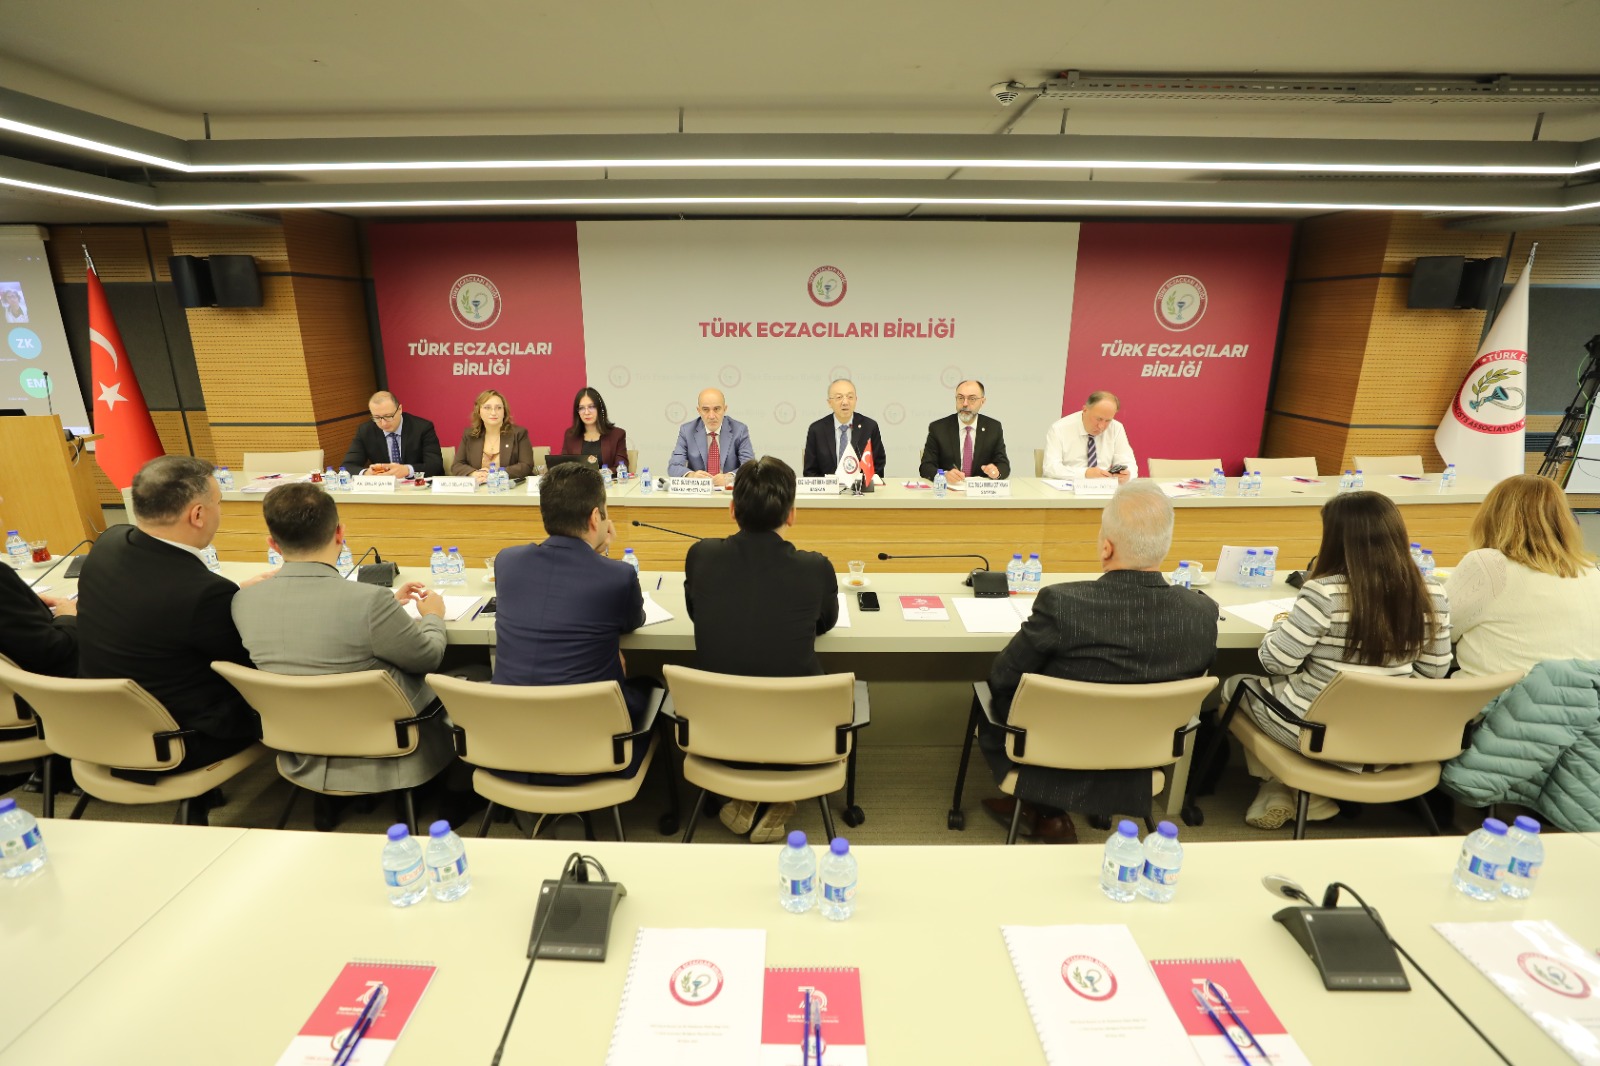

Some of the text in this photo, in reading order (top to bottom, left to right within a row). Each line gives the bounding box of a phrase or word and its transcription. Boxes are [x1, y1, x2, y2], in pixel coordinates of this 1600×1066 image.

[699, 317, 955, 339] TÜRK ECZACILARI BİRLİĞİ
[16, 338, 34, 348] ZK
[408, 339, 552, 356] TÜRK ECZACILARI
[1101, 340, 1249, 358] TÜRK ECZACILARI
[1486, 350, 1518, 362] TÜRK
[452, 358, 510, 376] BİRLİĞİ
[1141, 360, 1202, 378] BİRLİĞİ
[26, 378, 47, 389] EM
[1468, 421, 1521, 432] ASSOCIATION
